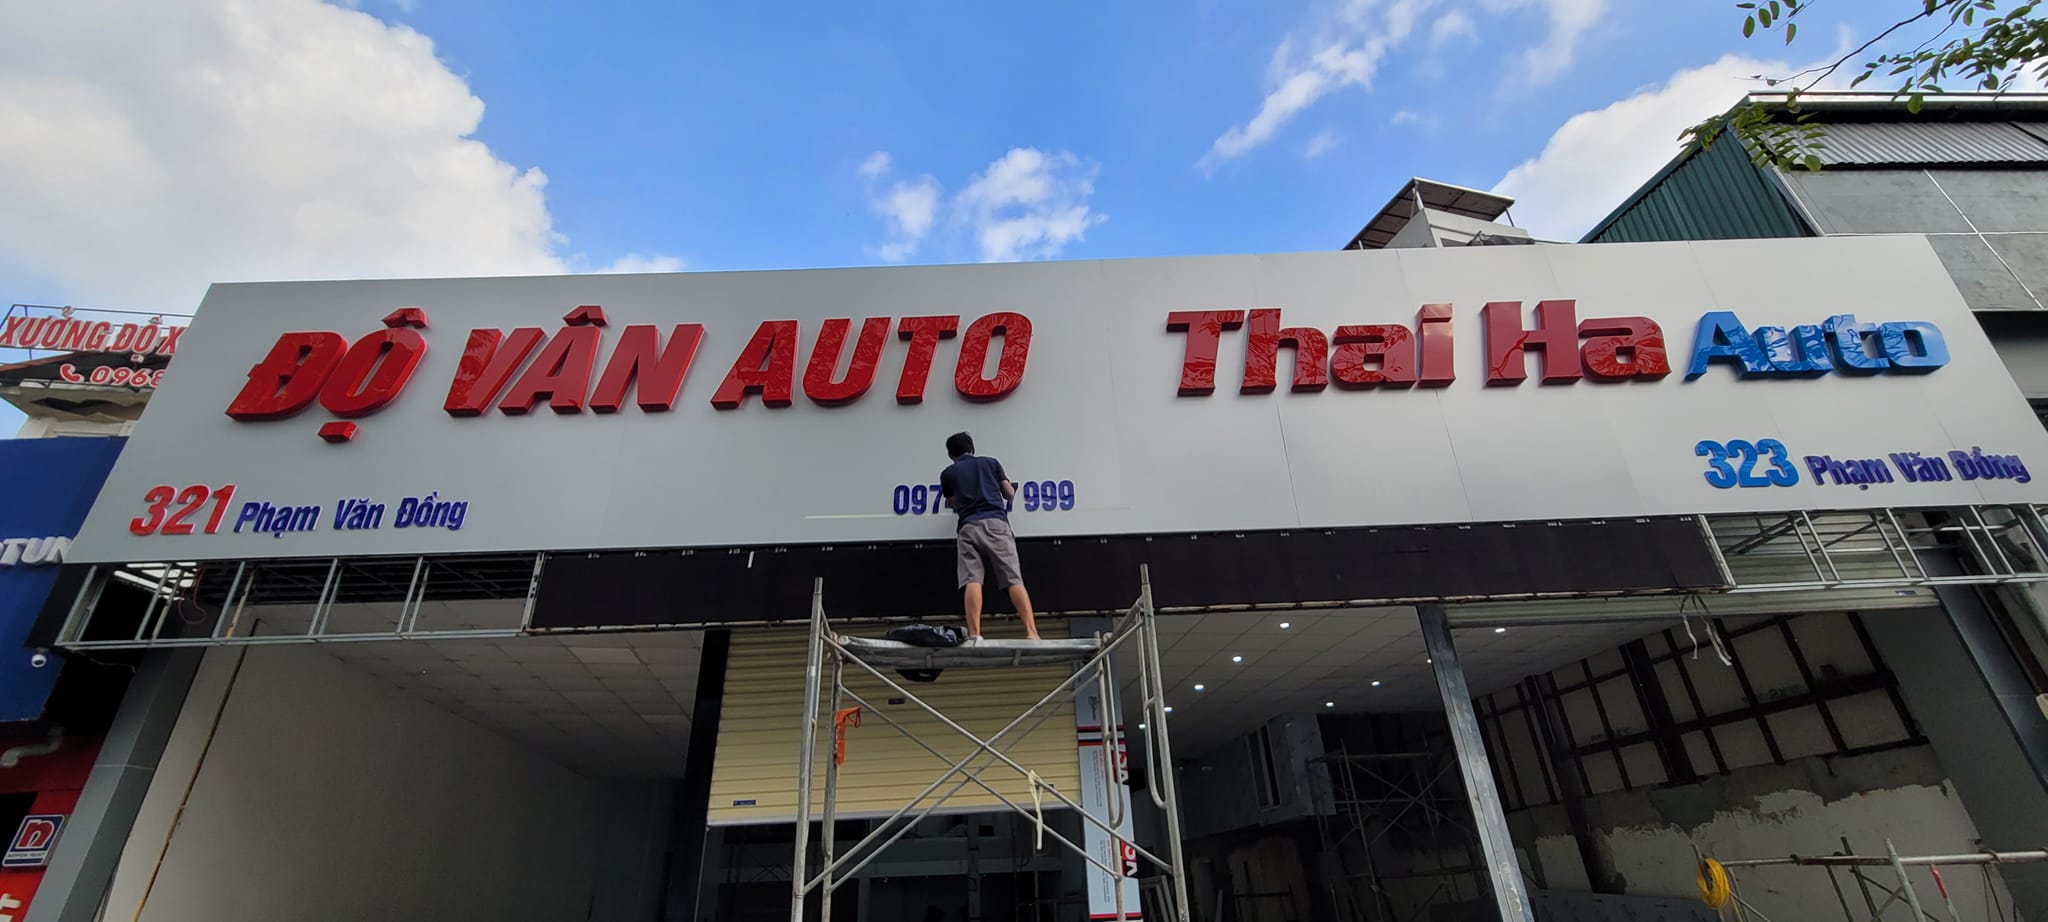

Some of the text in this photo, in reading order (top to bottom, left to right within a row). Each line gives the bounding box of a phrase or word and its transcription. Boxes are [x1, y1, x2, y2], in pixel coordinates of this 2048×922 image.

[0, 306, 112, 352] XƯỞNG
[112, 316, 163, 363] ĐỘ
[1166, 299, 1952, 398] Thai Ha Auto
[225, 305, 1034, 443] ĐỘ VÂN AUTO
[1695, 438, 1800, 489] 323
[1803, 453, 1894, 490] Phạm
[1888, 450, 1953, 484] Văn
[129, 484, 470, 538] 321 Phạm Văn Đồng
[1023, 479, 1075, 512] 999
